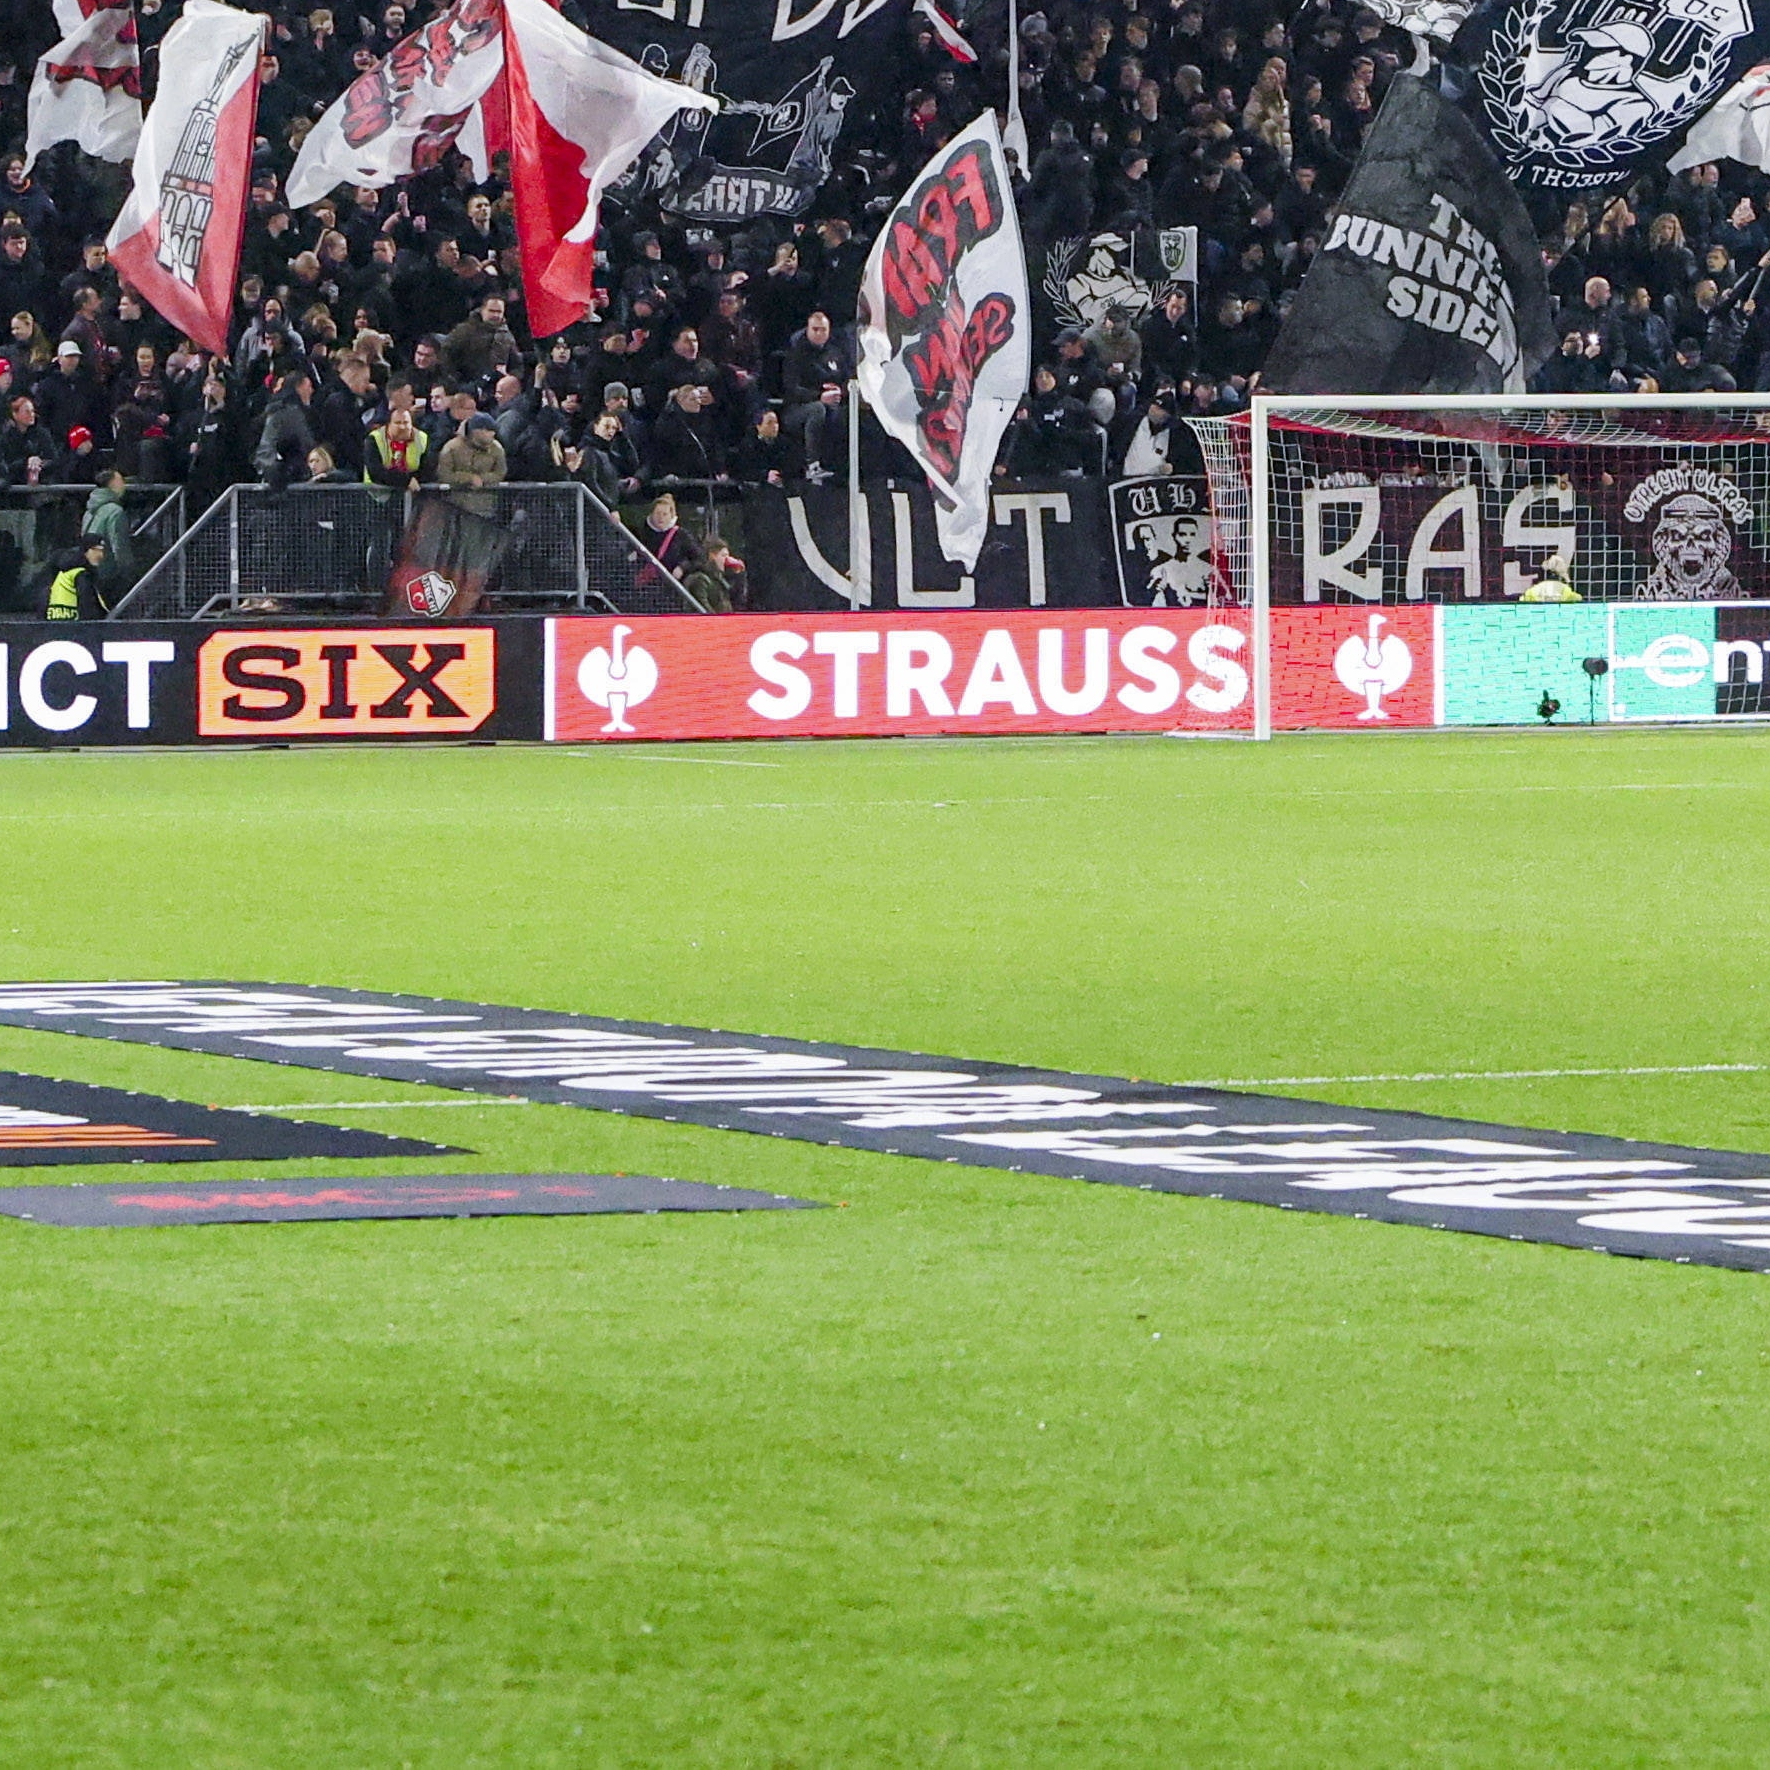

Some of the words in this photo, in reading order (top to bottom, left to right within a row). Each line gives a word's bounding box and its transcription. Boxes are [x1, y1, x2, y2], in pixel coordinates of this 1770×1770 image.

[1623, 467, 1692, 523] UTRECHT
[1692, 468, 1755, 525] ULTRAS
[222, 644, 472, 721] SIX
[746, 623, 1250, 720] STRAUSS
